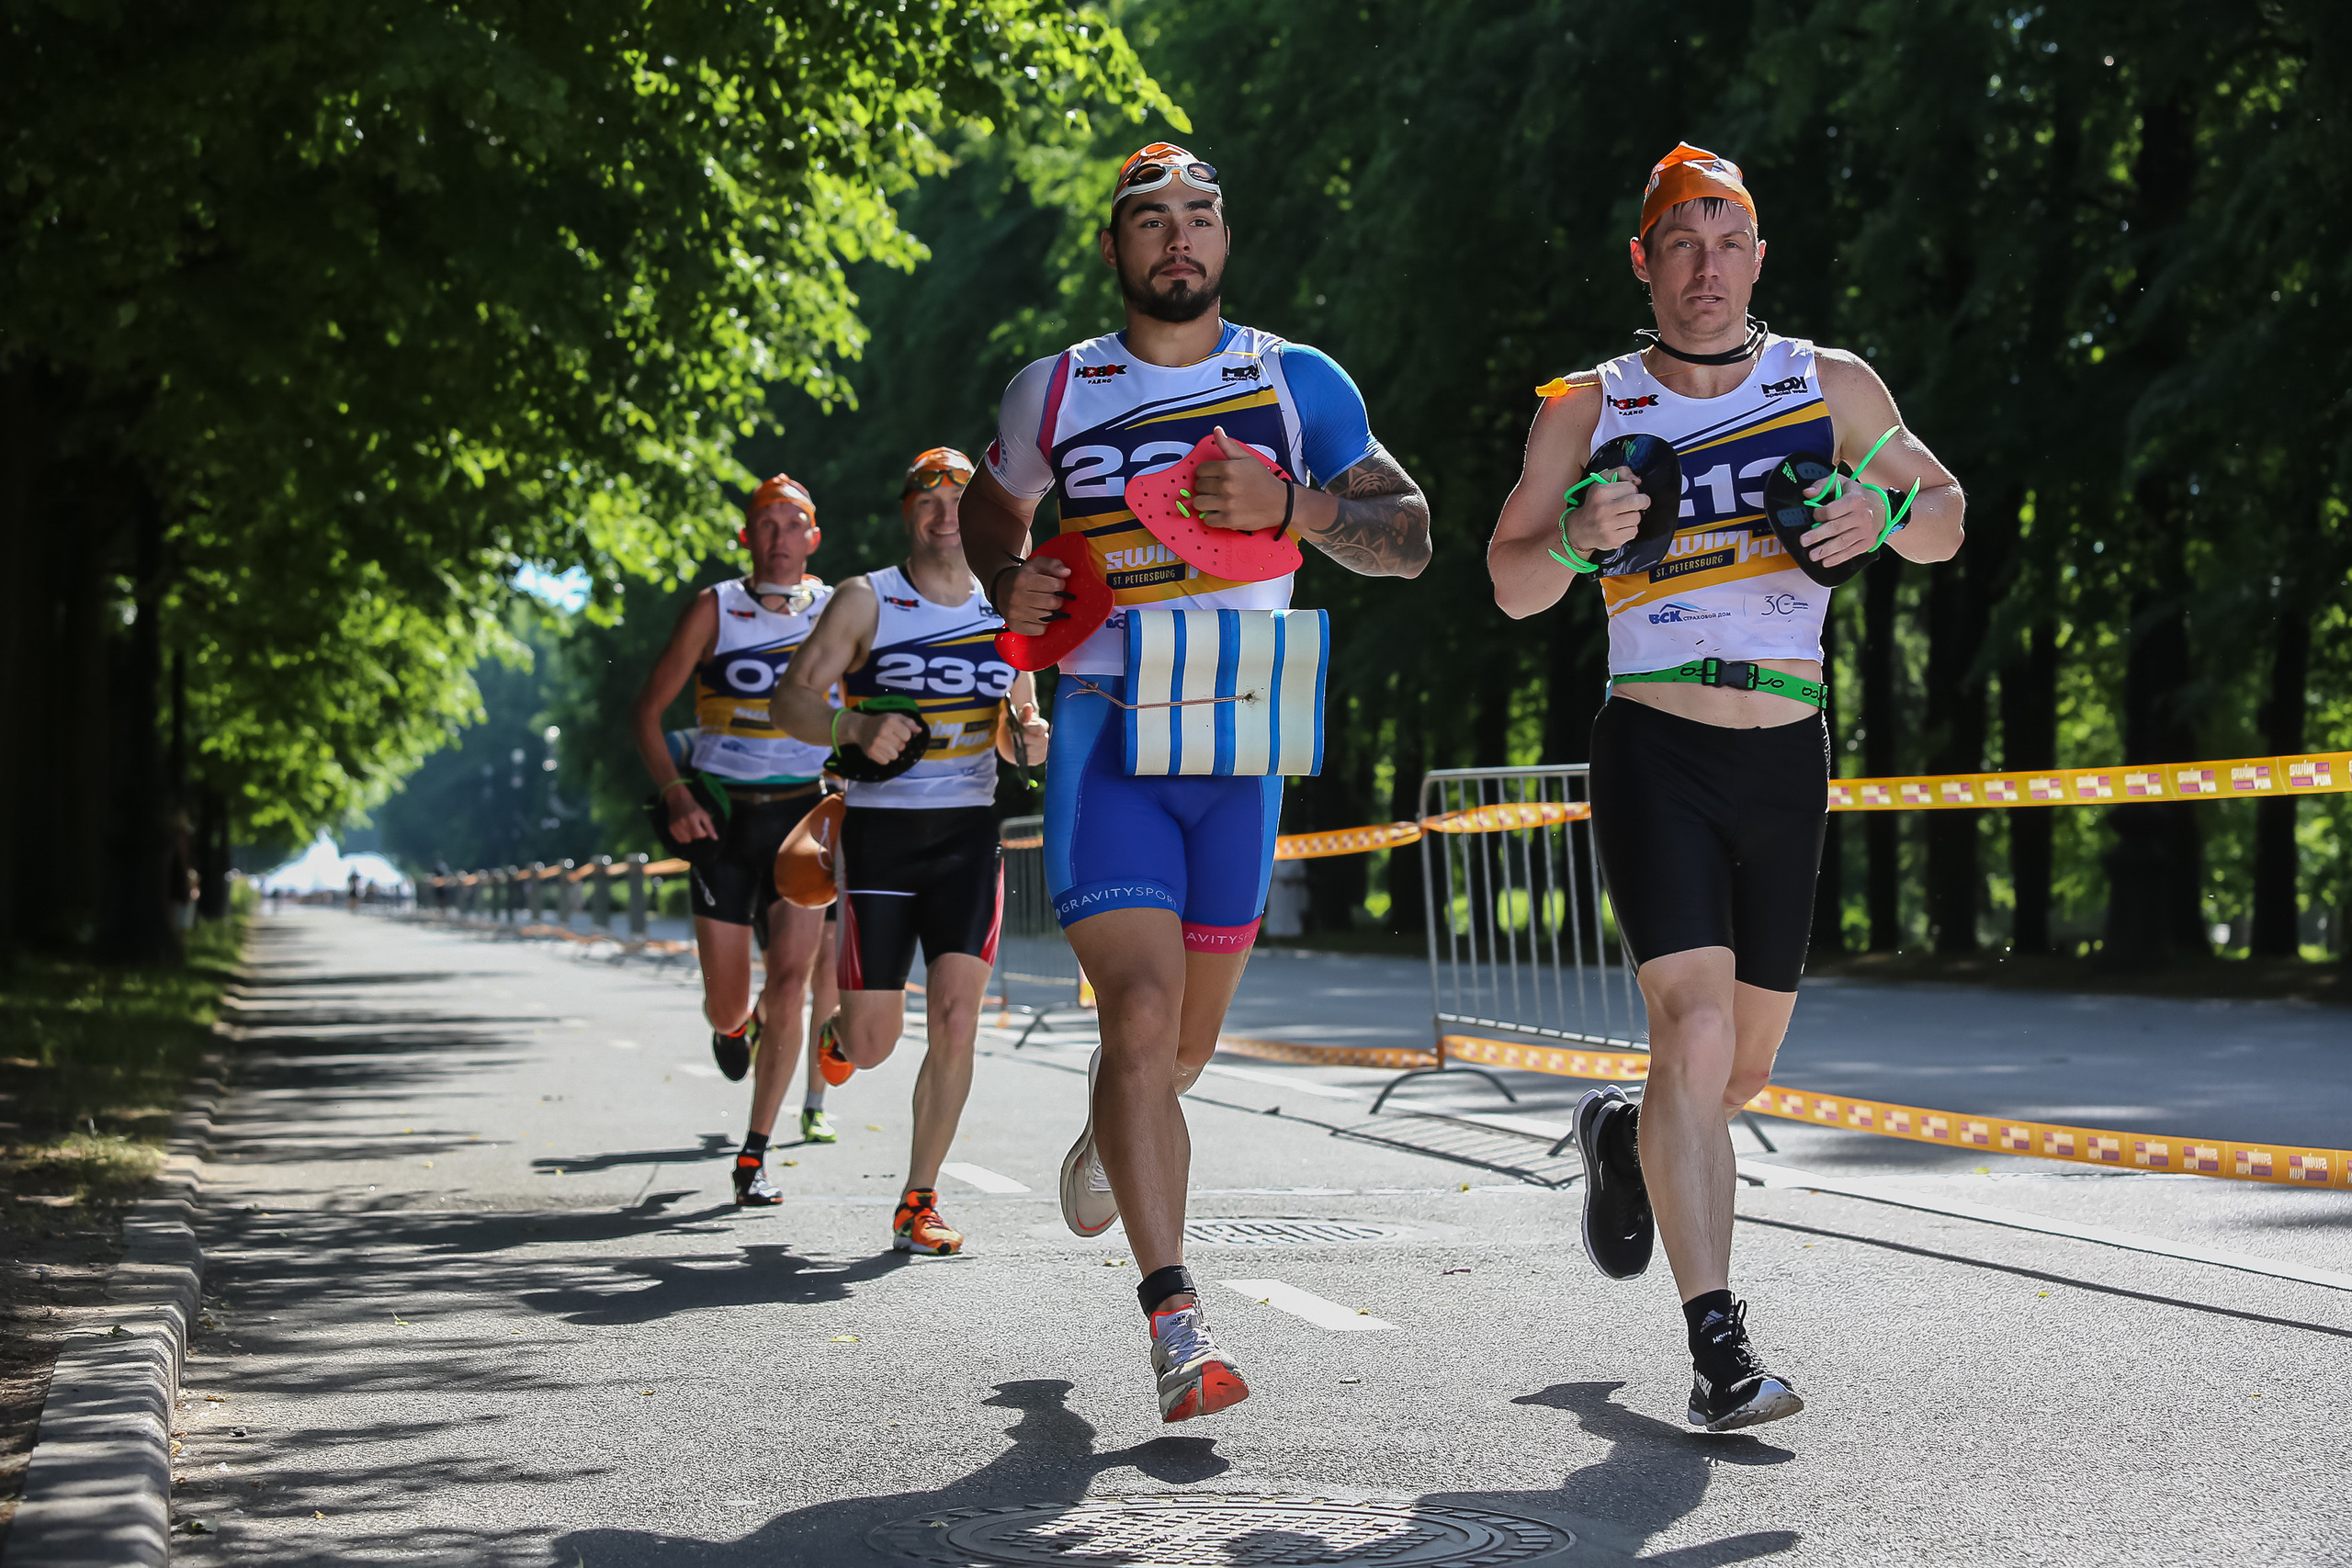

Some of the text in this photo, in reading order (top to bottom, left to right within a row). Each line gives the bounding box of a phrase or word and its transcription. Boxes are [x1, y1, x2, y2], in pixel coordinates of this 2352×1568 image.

[1061, 441, 1277, 499] 22
[1125, 569, 1175, 584] PETERSBURG
[1656, 555, 1724, 578] ST. PETERSBURG
[1648, 610, 1731, 625] ВСК СТРАХОВОЙ ДОМ
[876, 652, 1016, 698] 233
[1695, 1370, 1713, 1399] HOKA
